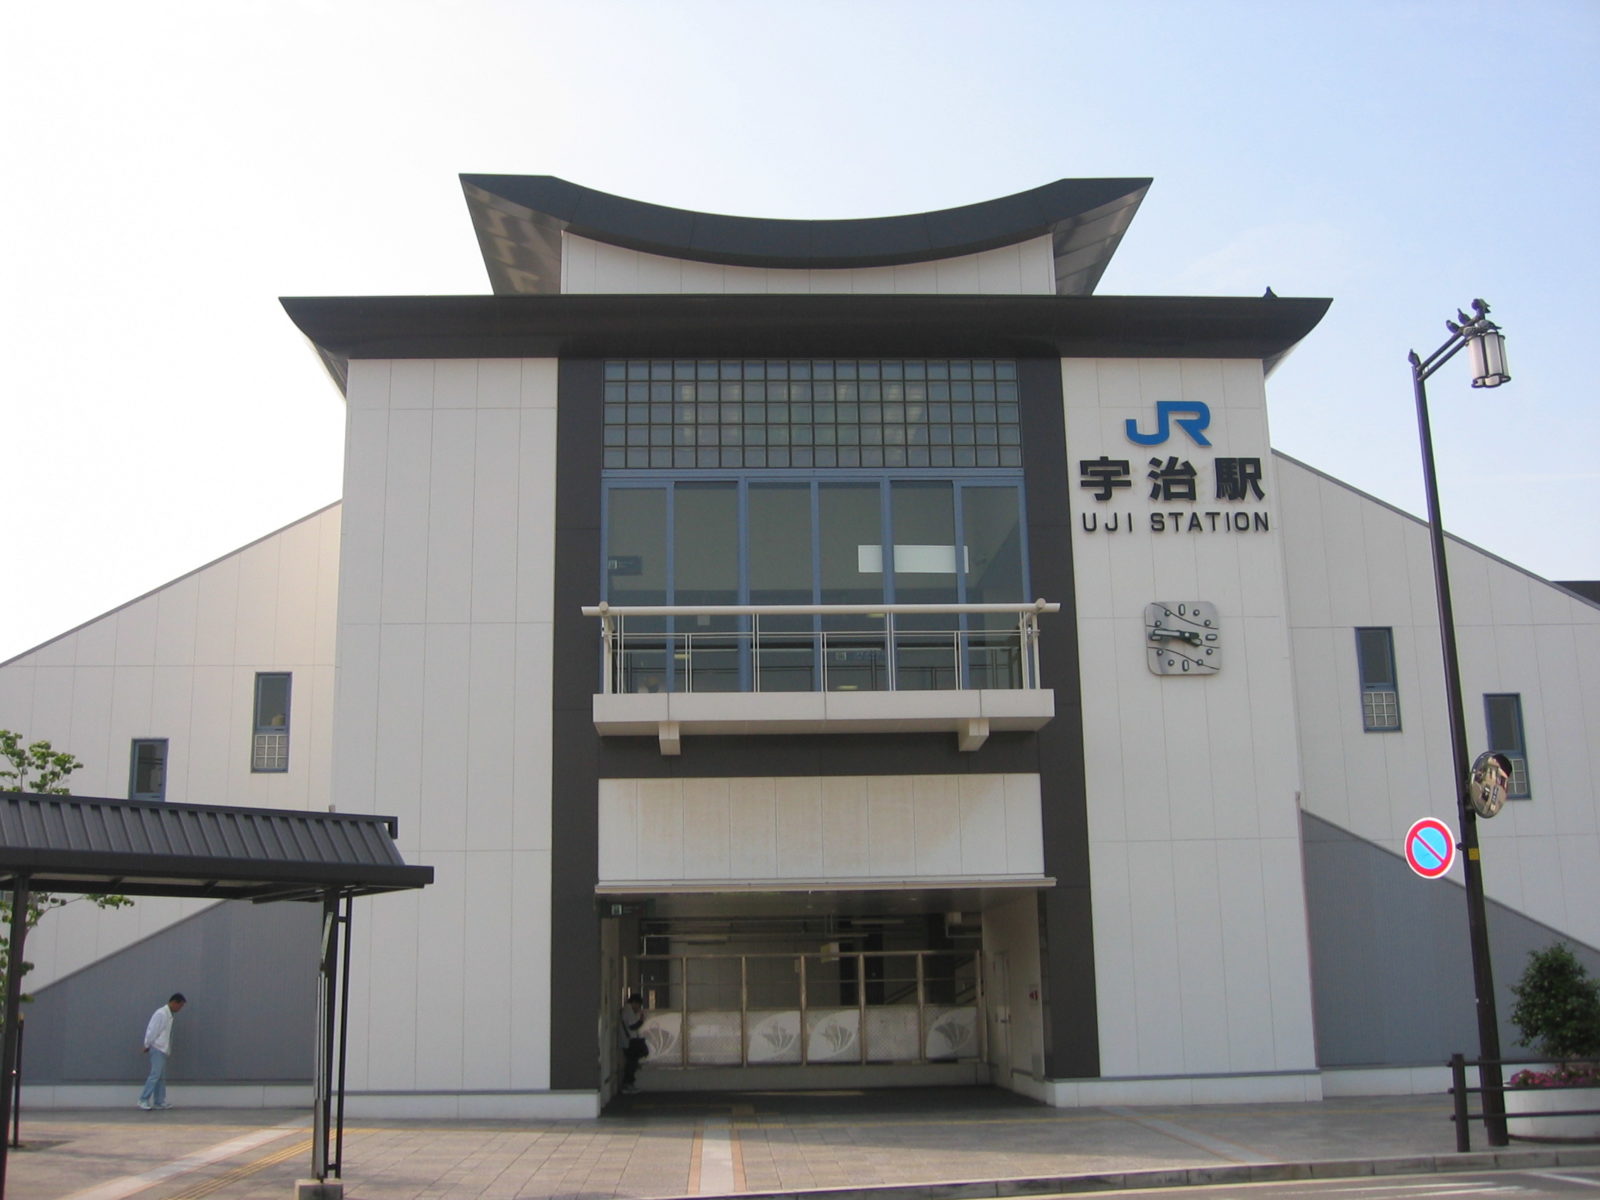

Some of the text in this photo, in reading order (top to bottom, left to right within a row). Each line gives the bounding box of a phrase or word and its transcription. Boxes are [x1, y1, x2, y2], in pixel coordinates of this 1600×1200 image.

[1125, 401, 1213, 446] JR
[1079, 456, 1266, 501] 宇治駅
[1082, 511, 1269, 532] UJI STATION
